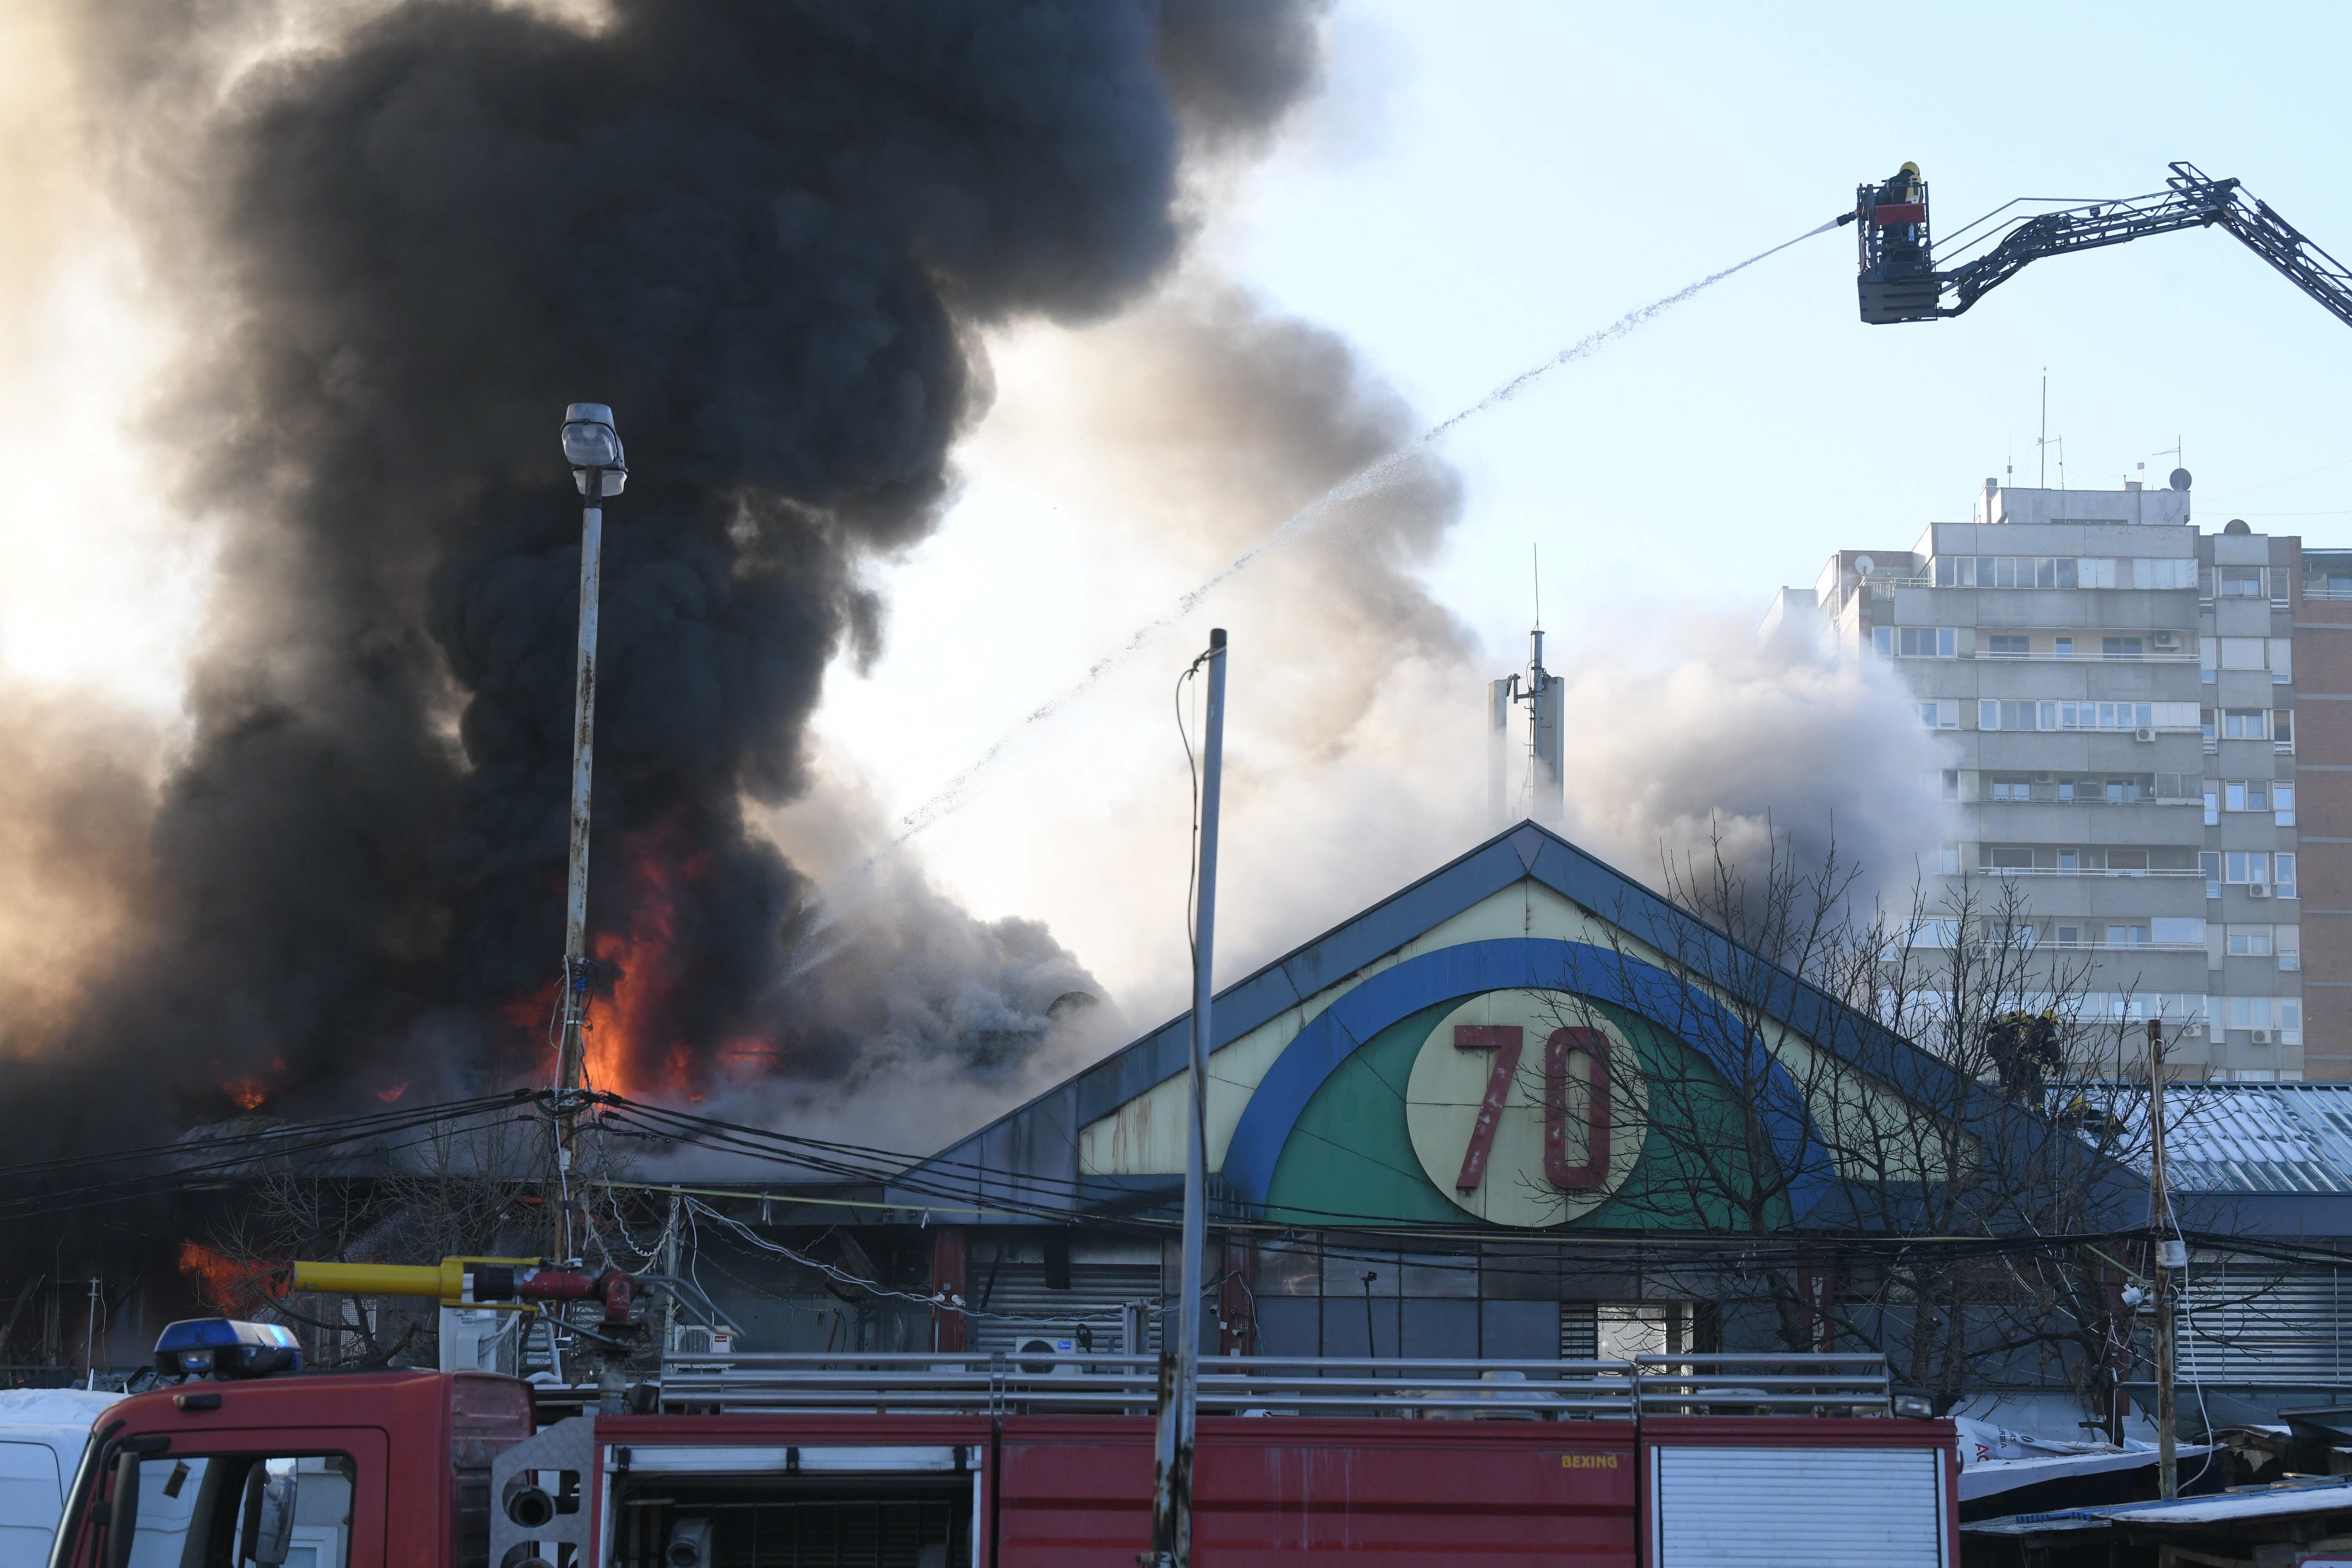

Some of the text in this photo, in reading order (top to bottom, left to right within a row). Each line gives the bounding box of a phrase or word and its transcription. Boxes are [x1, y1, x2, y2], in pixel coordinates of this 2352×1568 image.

[1454, 1026, 1610, 1189] 70
[1998, 1427, 2007, 1449] ERBIA
[1562, 1455, 1617, 1468] BEXING
